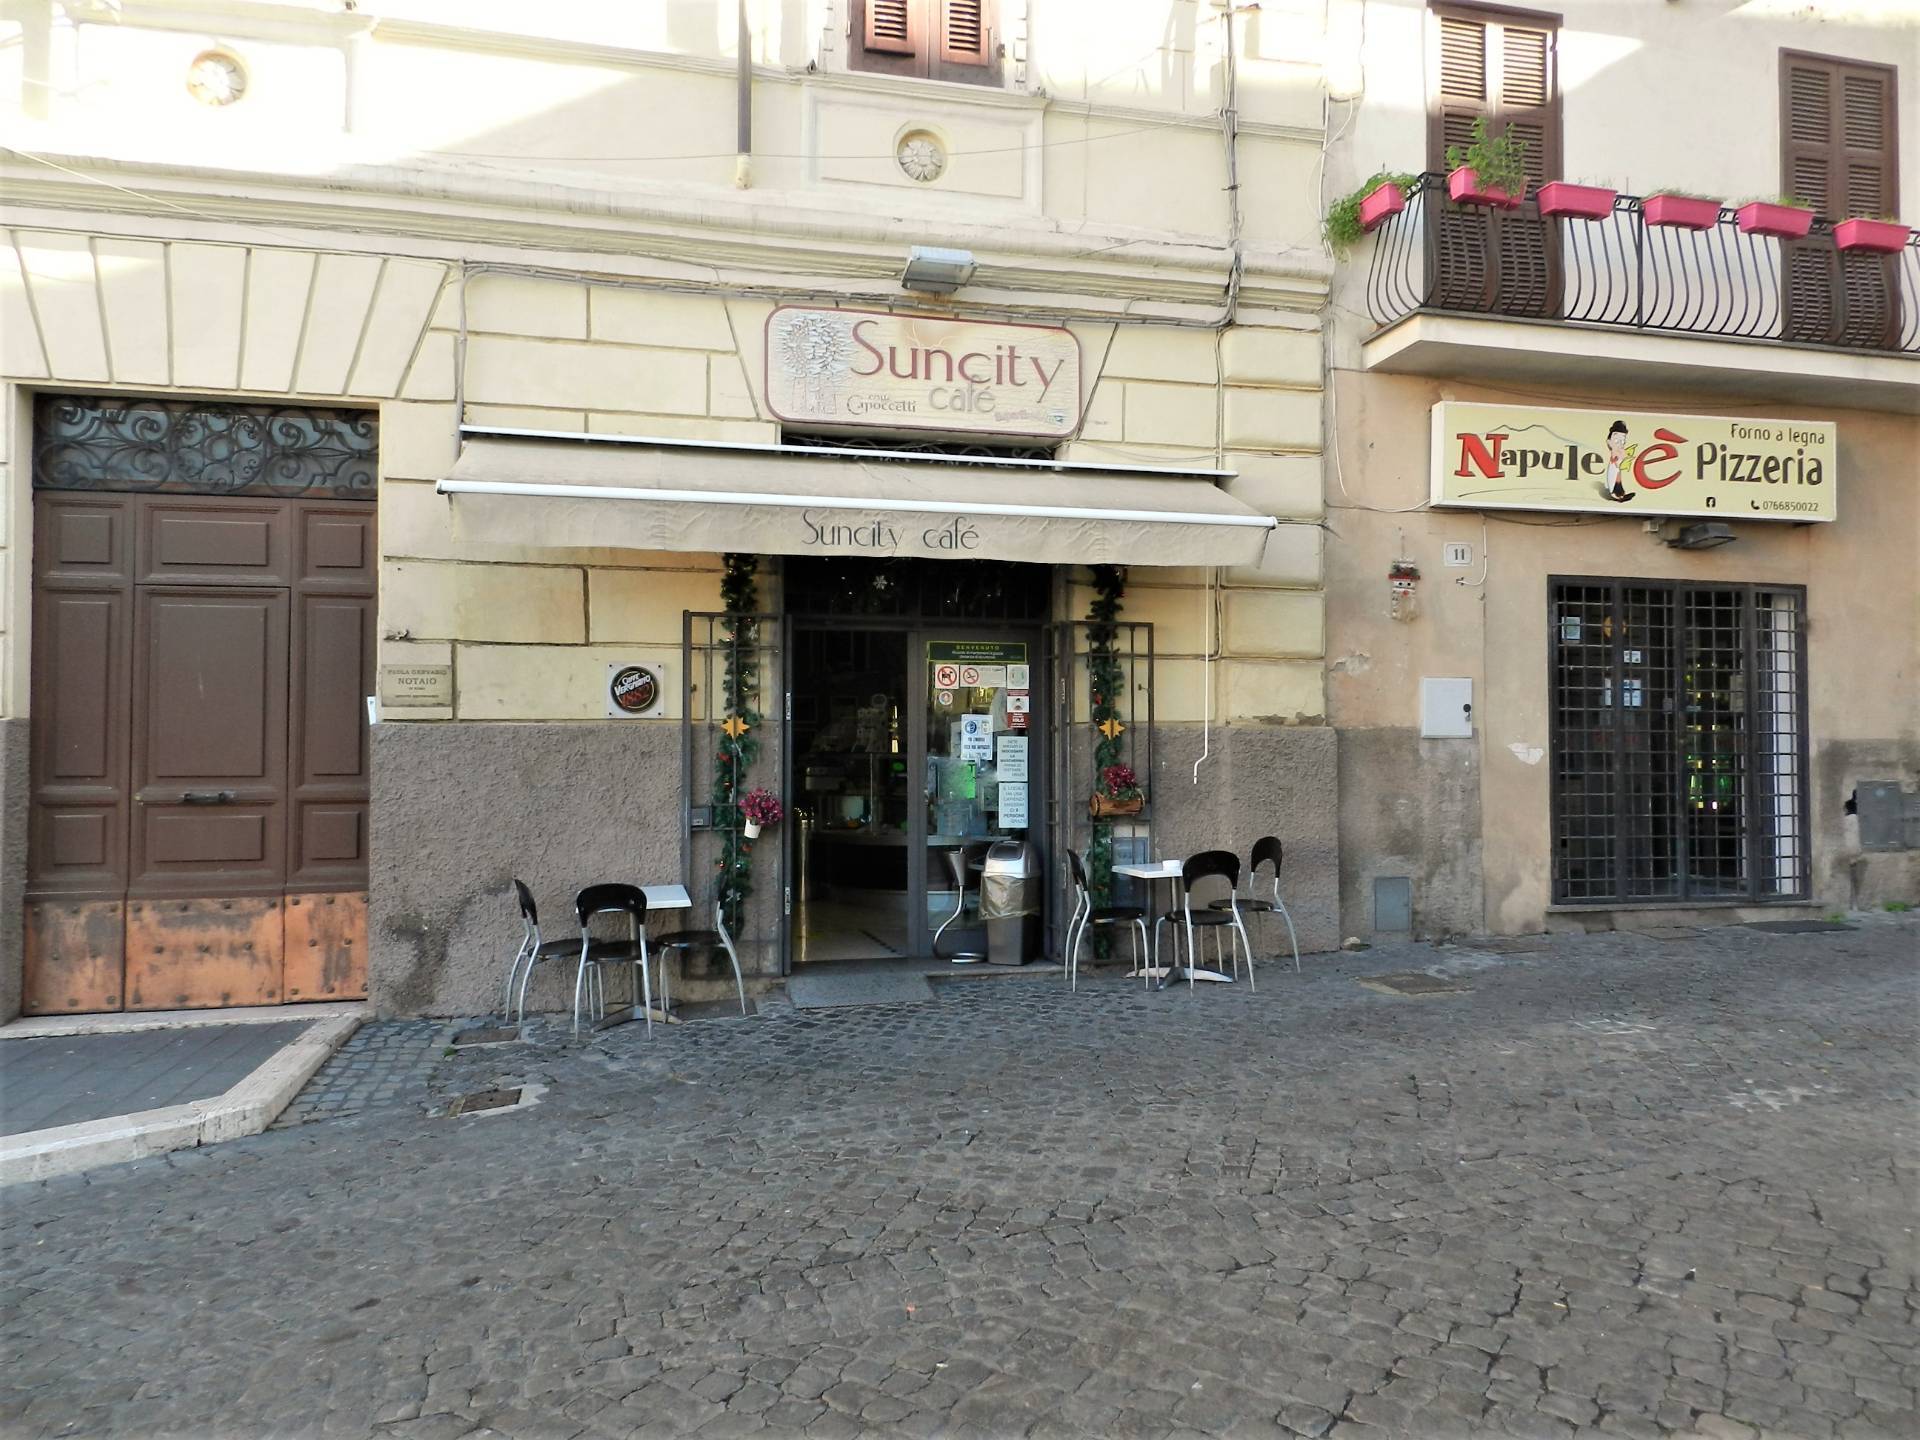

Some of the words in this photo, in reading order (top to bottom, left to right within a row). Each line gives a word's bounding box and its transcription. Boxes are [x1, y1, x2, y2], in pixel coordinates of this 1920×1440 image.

[850, 320, 1065, 404] Suncity
[928, 374, 997, 415] café
[1731, 423, 1771, 442] Forno
[1775, 430, 1784, 442] a
[1788, 427, 1826, 447] legna
[1454, 432, 1605, 482] Napule
[1633, 428, 1689, 490] è
[1696, 441, 1823, 486] Pizzeria
[1762, 500, 1820, 513] 0766850022
[802, 510, 905, 556] Suncity
[922, 517, 980, 551] café
[1453, 547, 1466, 561] 11
[397, 677, 437, 686] NOTAIO
